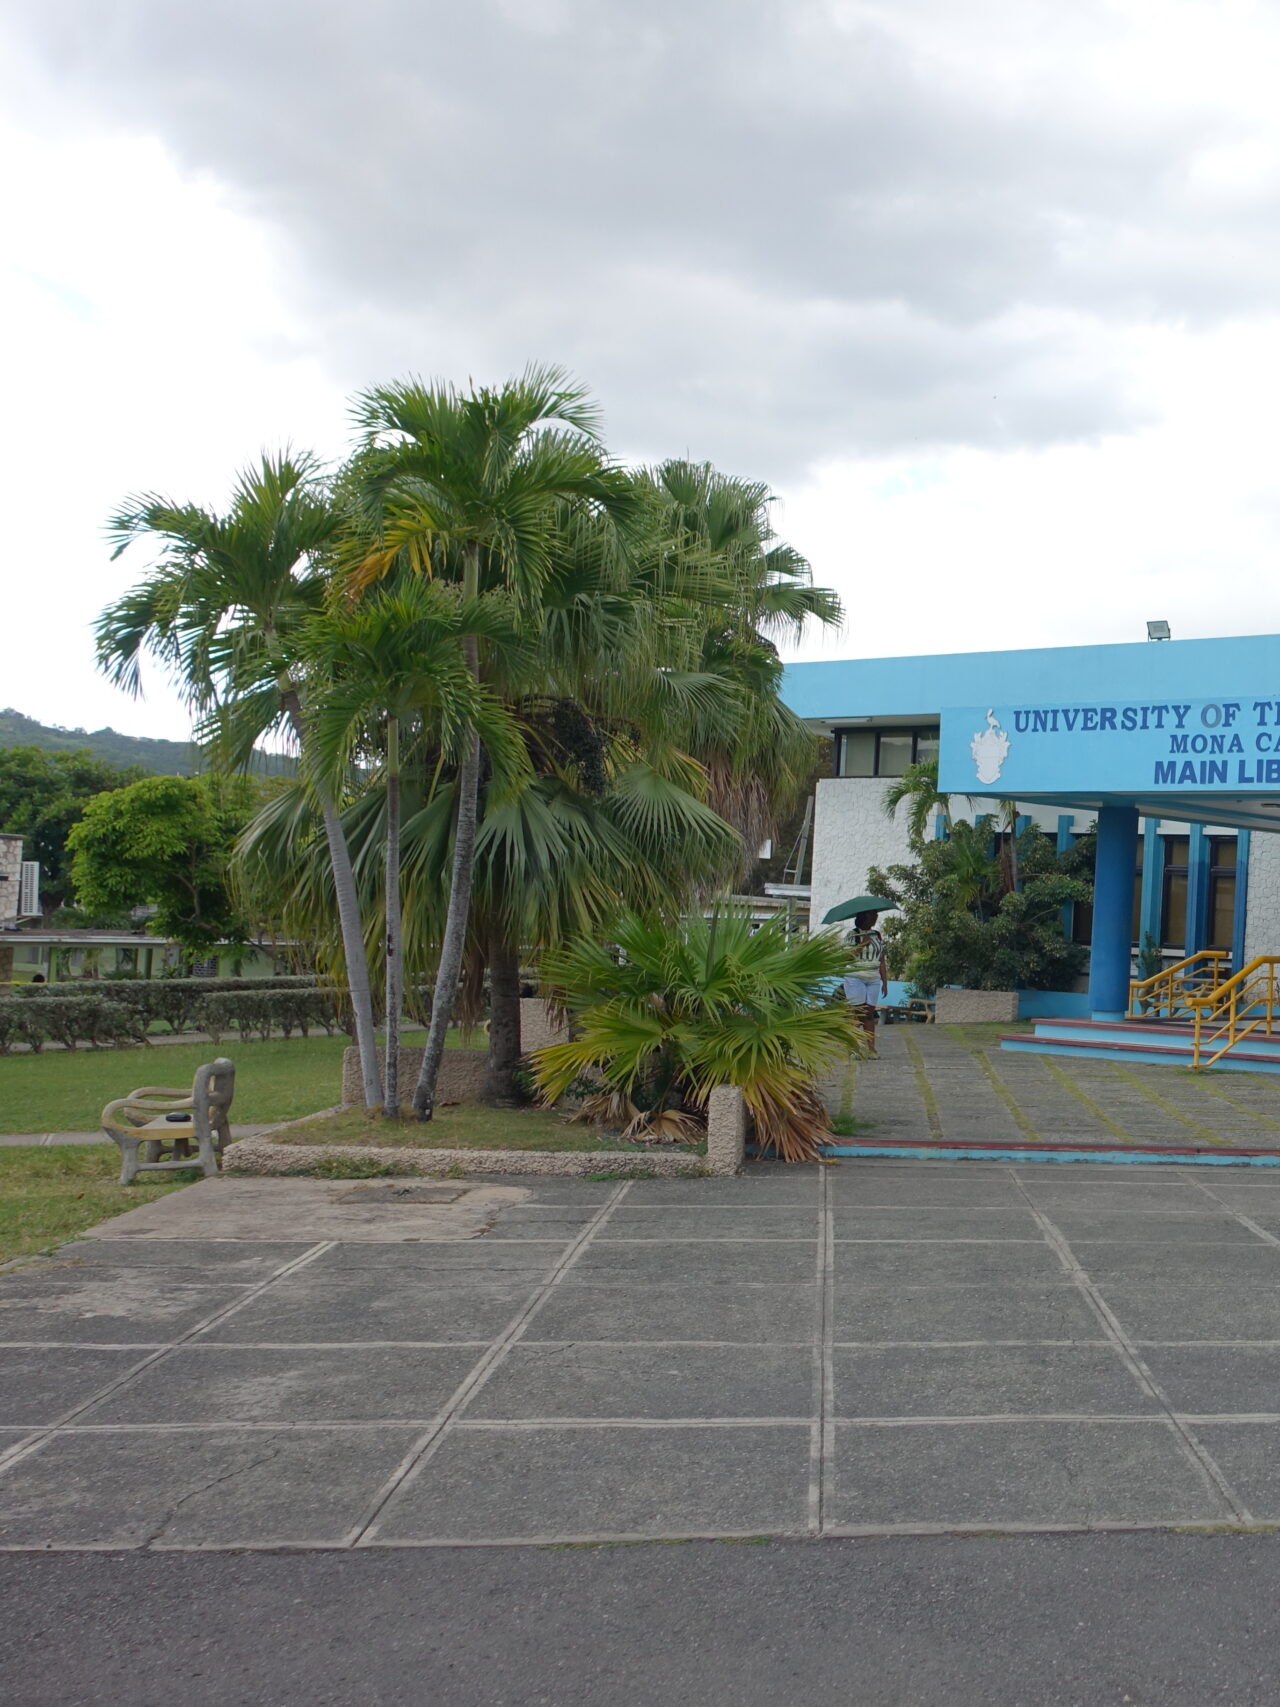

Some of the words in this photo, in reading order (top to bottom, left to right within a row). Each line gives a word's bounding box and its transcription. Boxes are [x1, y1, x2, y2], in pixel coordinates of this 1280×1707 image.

[1014, 704, 1191, 733] UNIVERSITY
[1201, 703, 1241, 728] OF
[1169, 733, 1245, 755] MONA
[1154, 760, 1228, 785] MAIN
